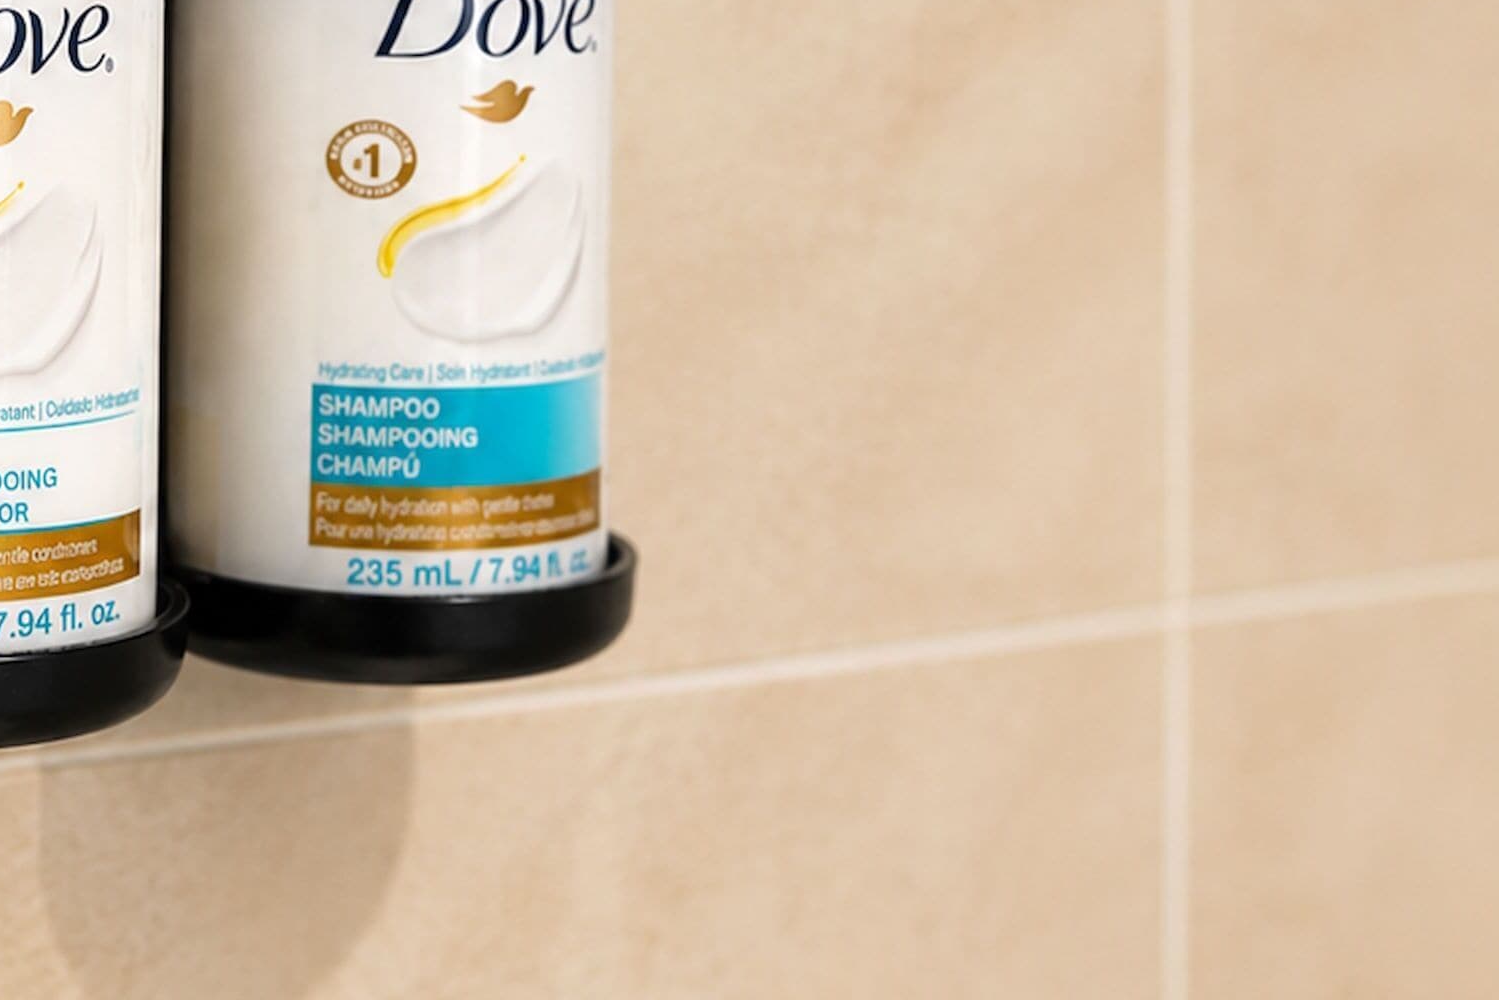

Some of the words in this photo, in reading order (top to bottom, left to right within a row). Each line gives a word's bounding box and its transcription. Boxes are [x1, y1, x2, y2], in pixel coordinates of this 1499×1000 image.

[389, 363, 425, 380] Care
[318, 393, 441, 419] SHAMPOO
[318, 423, 479, 448] SHAMPOOING
[317, 452, 421, 479] CHAMPÚ
[347, 557, 402, 587] 235
[414, 559, 462, 586] mL
[489, 553, 541, 584] 7.94
[60, 603, 83, 632] fl.
[91, 600, 120, 626] oz.
